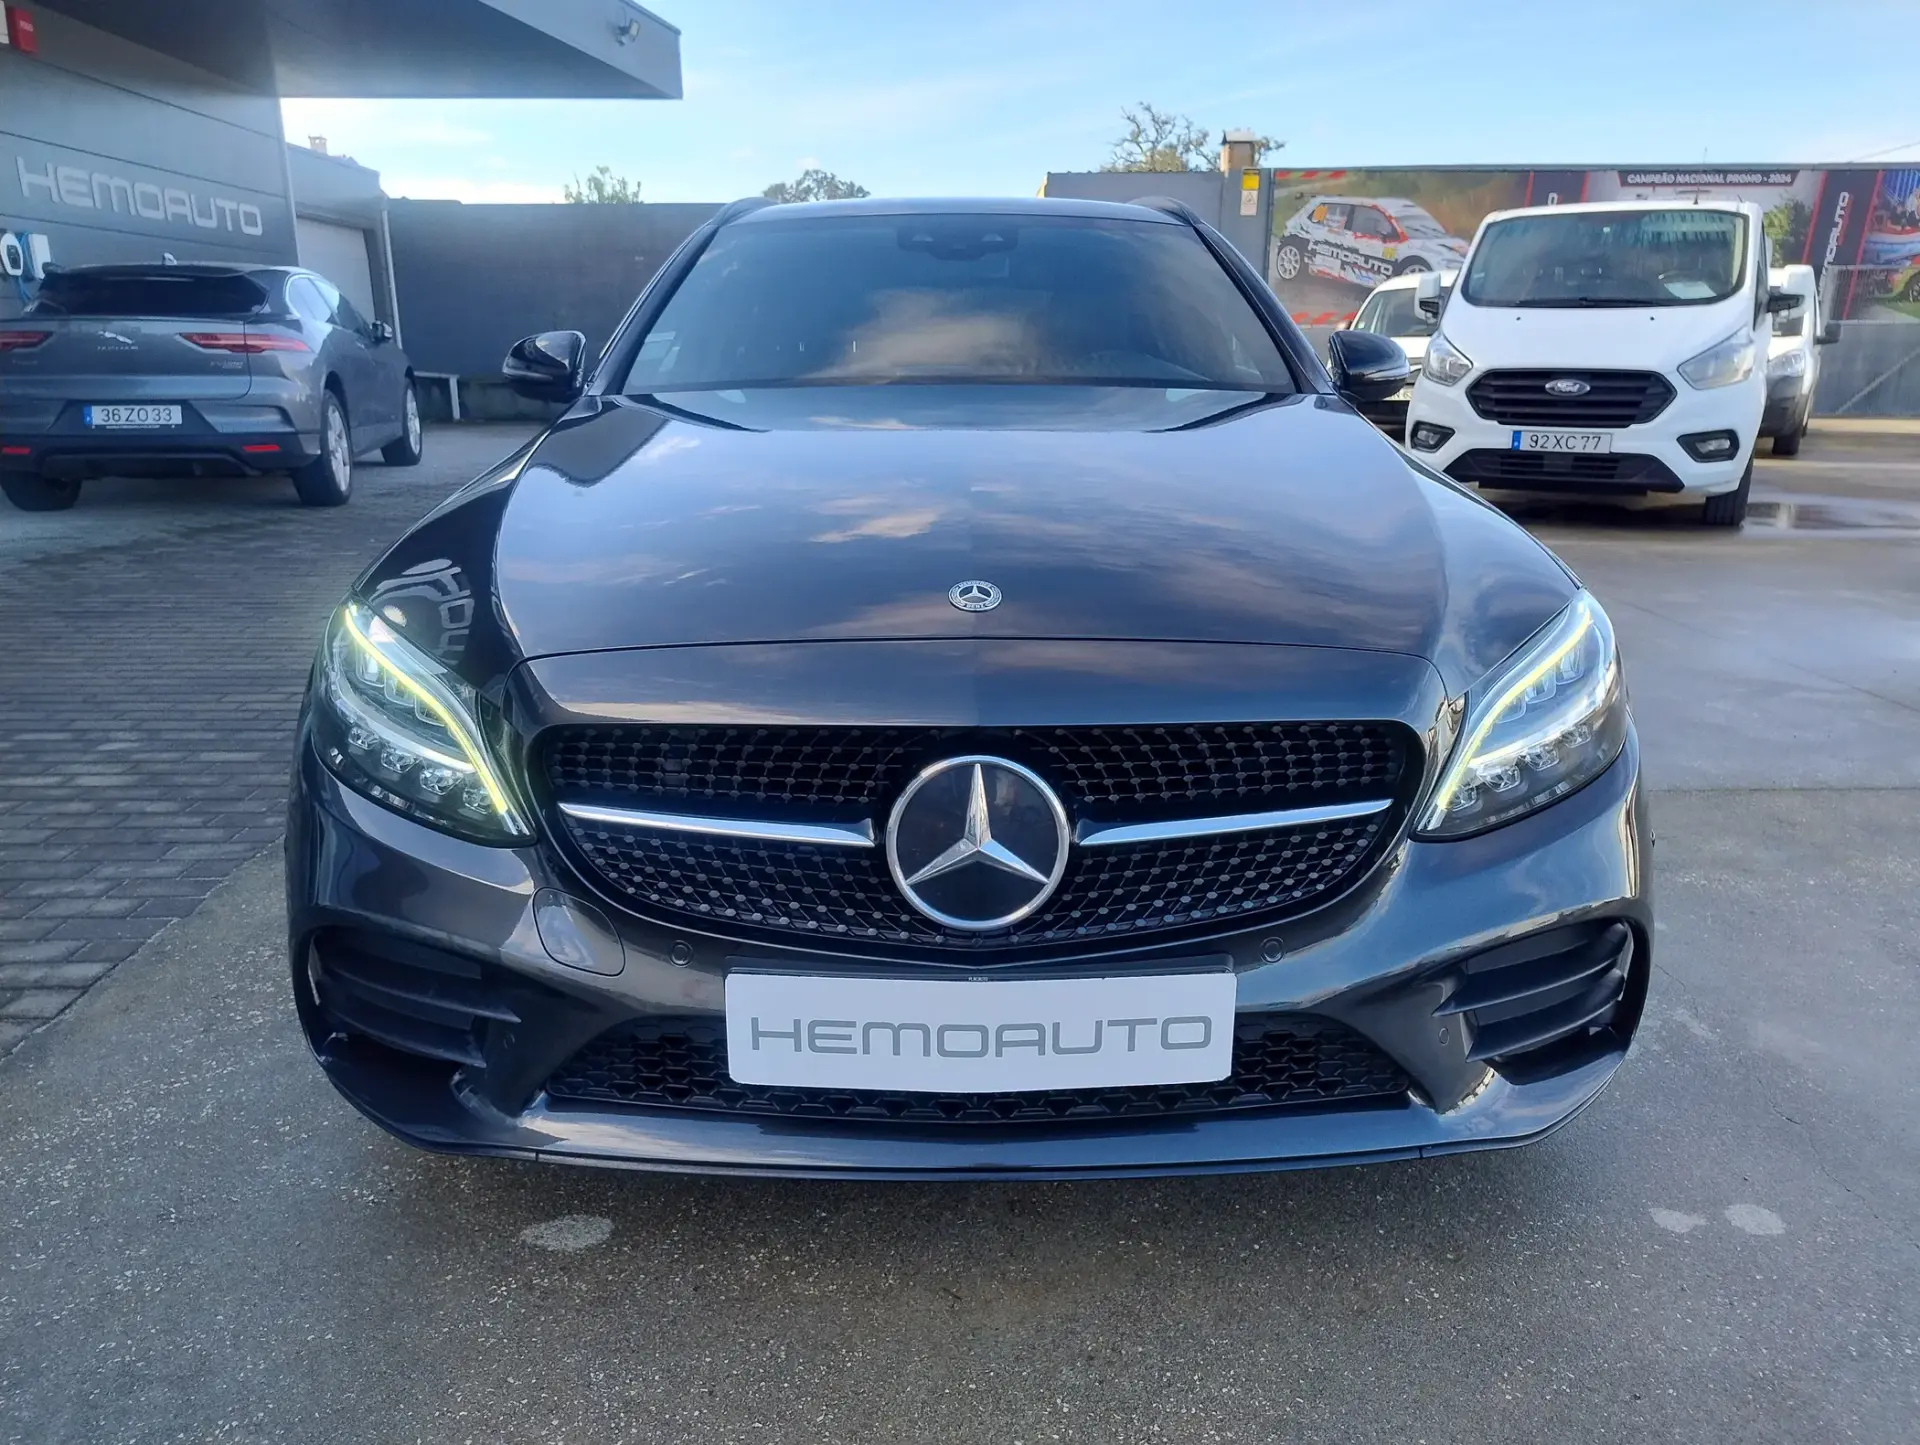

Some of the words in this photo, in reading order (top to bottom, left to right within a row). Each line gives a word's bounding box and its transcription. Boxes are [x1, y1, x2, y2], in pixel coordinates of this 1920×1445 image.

[16, 156, 263, 236] HEMOAUTO
[1676, 173, 1725, 184] NACIONAL
[1308, 239, 1393, 275] HEMOAUTO
[750, 1015, 1213, 1058] HEMOAUTO
